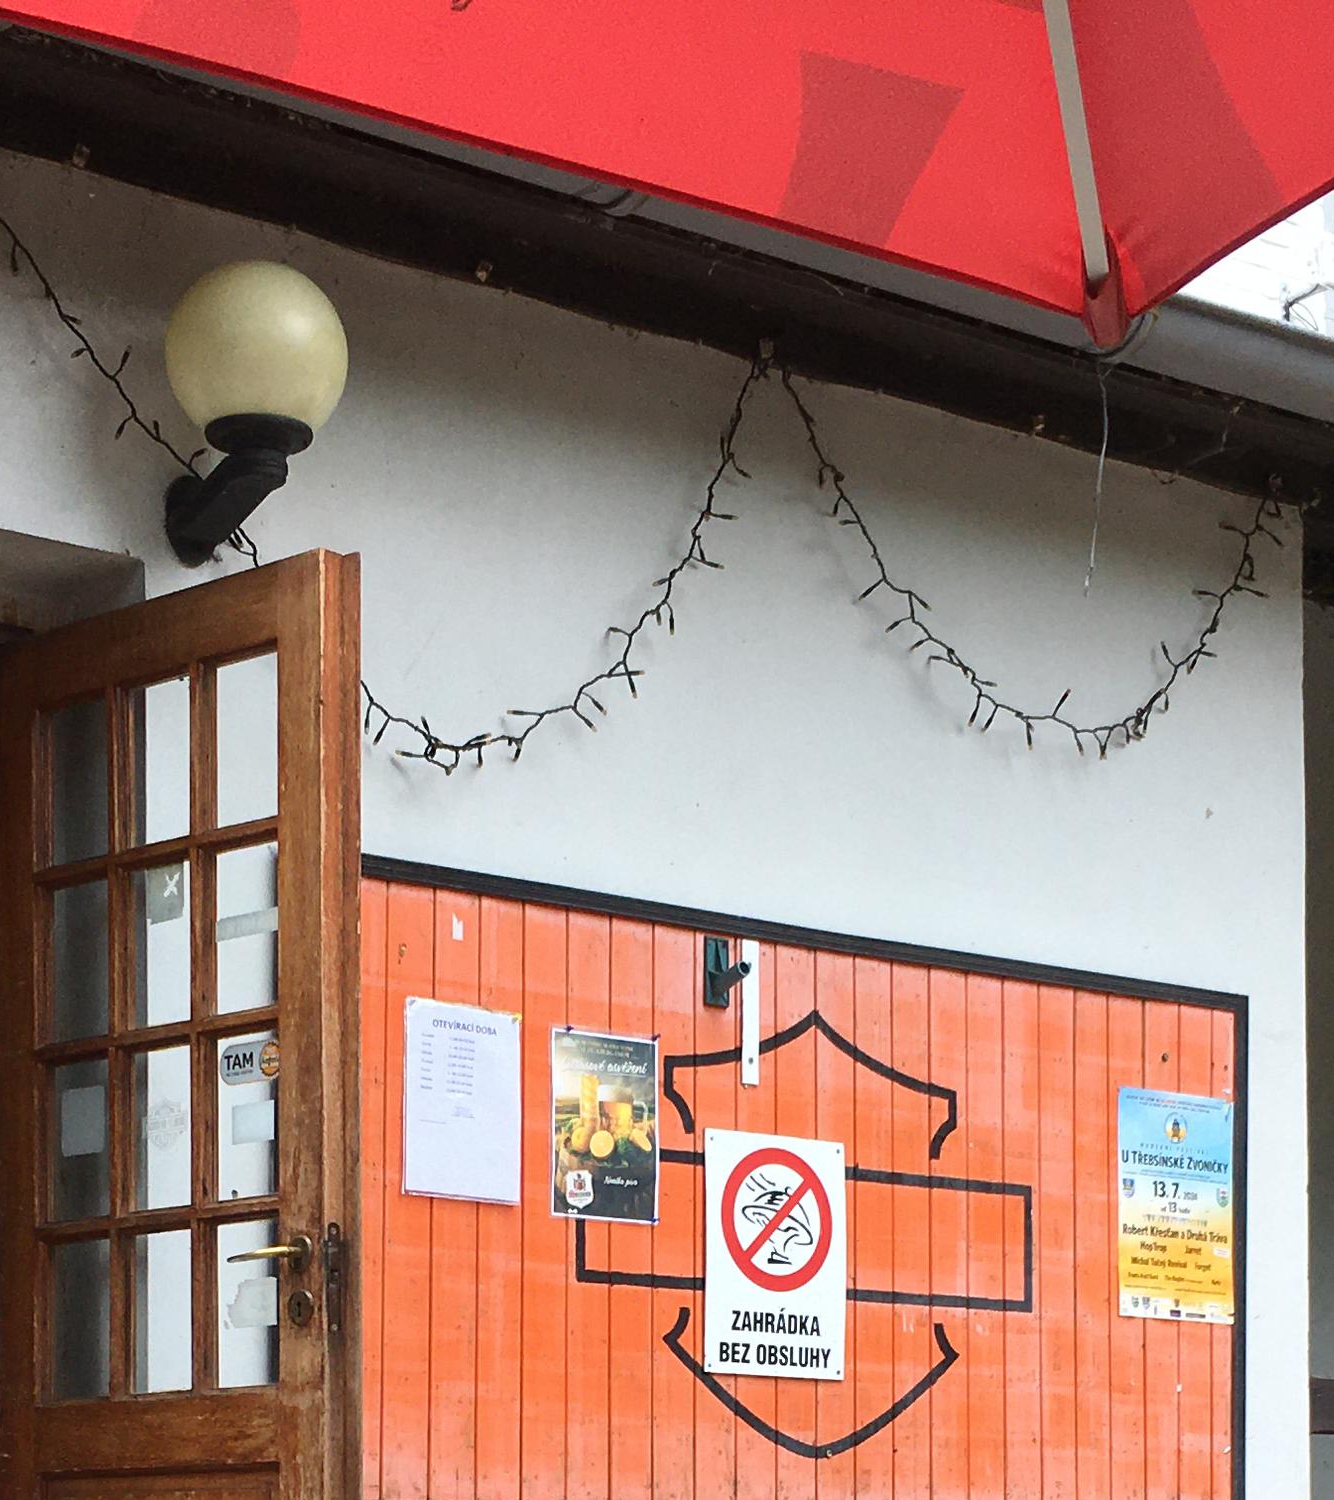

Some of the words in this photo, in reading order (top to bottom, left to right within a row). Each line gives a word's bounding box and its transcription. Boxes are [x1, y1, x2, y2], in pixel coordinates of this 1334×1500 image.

[475, 1024, 498, 1036] DOBA
[224, 1051, 254, 1071] TAM
[1121, 1150, 1129, 1163] U
[1152, 1180, 1169, 1198] 13.
[1171, 1182, 1181, 1200] 7.
[1168, 1201, 1177, 1213] 13
[1122, 1223, 1148, 1236] Robert
[731, 1307, 821, 1337] ZAHRÁDKA
[719, 1341, 751, 1364] BEZ
[756, 1343, 832, 1369] OBSLUHY
